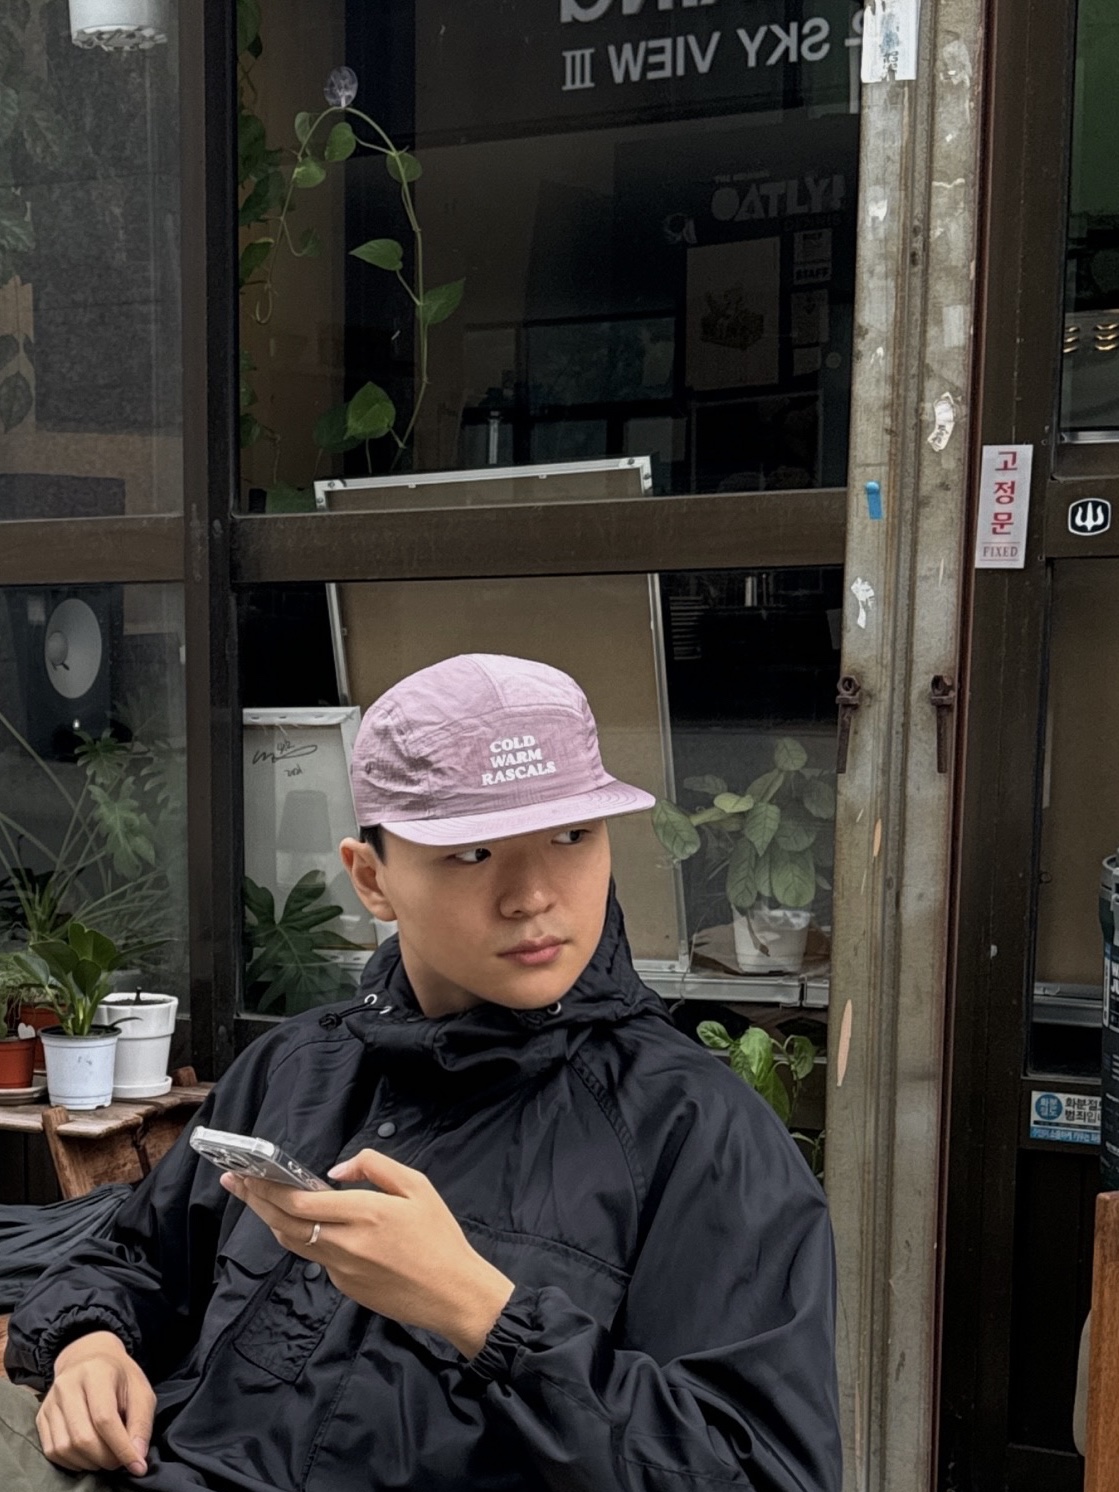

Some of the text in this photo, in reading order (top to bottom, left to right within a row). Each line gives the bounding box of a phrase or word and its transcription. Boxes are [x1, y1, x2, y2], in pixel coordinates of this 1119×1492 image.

[991, 451, 1018, 535] 고정문
[983, 546, 1019, 558] FIXED
[489, 735, 536, 753] COLD
[490, 748, 542, 768] WARM
[481, 761, 557, 786] RASCALS
